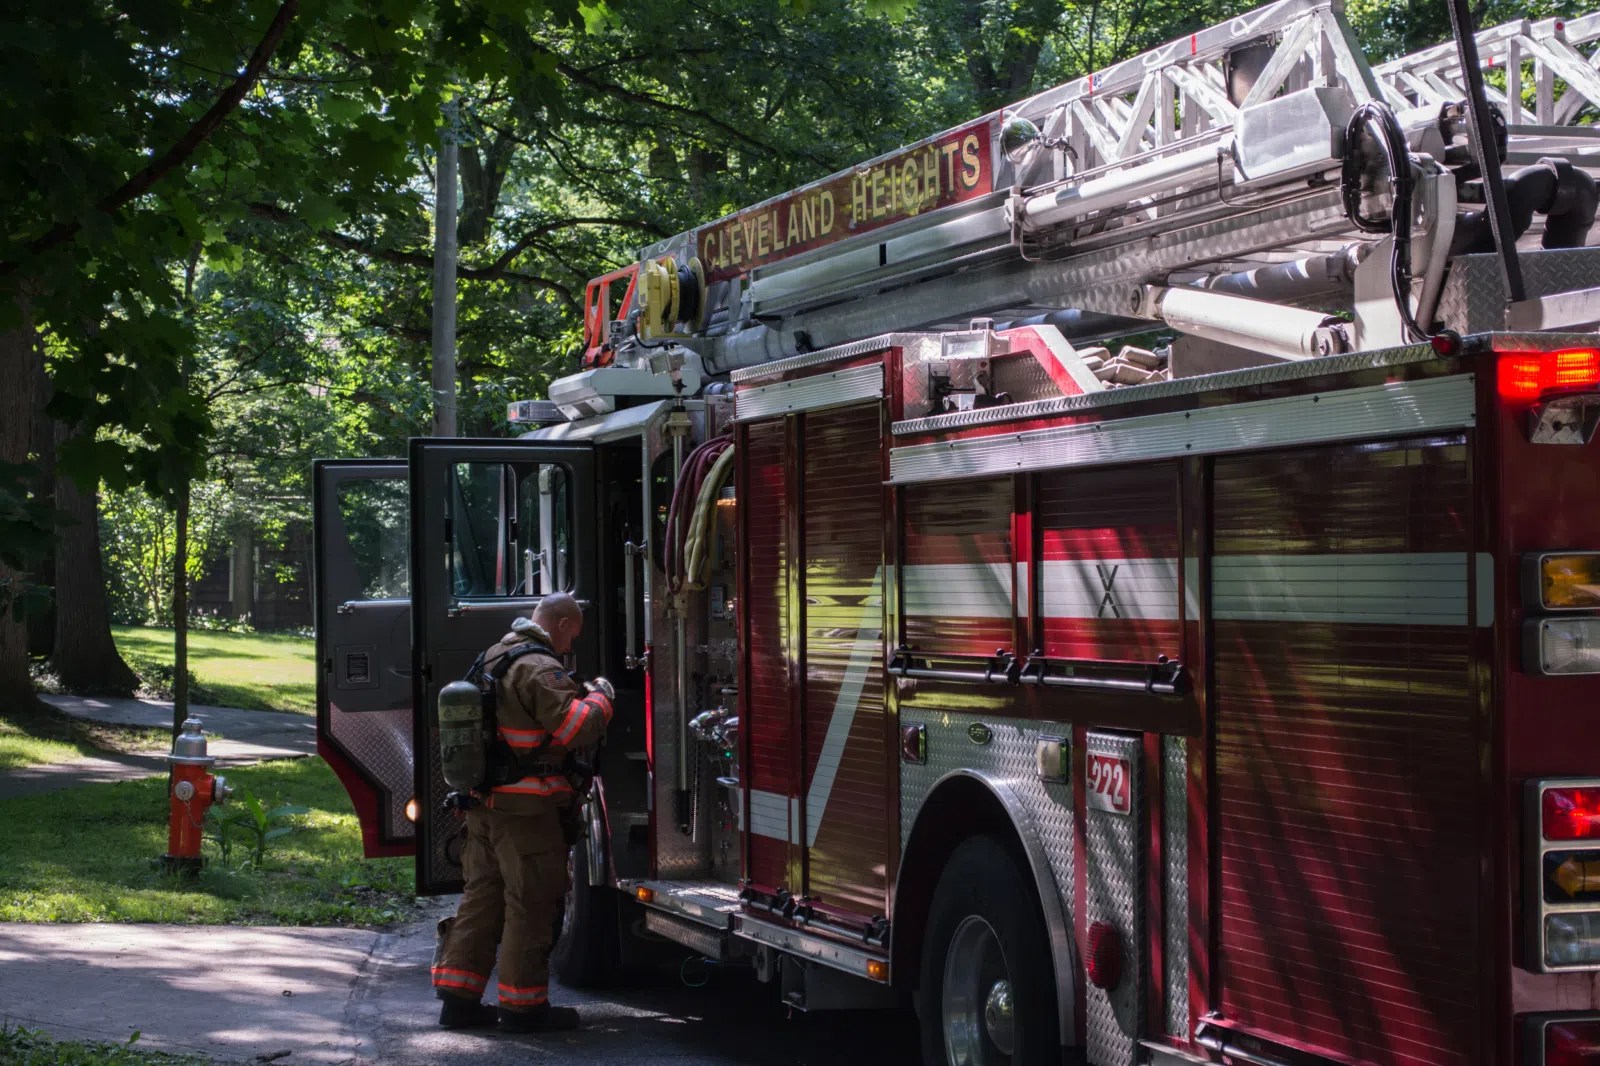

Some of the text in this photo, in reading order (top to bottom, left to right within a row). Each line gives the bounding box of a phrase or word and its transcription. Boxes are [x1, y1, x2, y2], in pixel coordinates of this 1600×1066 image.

[703, 132, 981, 272] CLEVELAND HEIGHTS
[1091, 760, 1124, 805] 222
